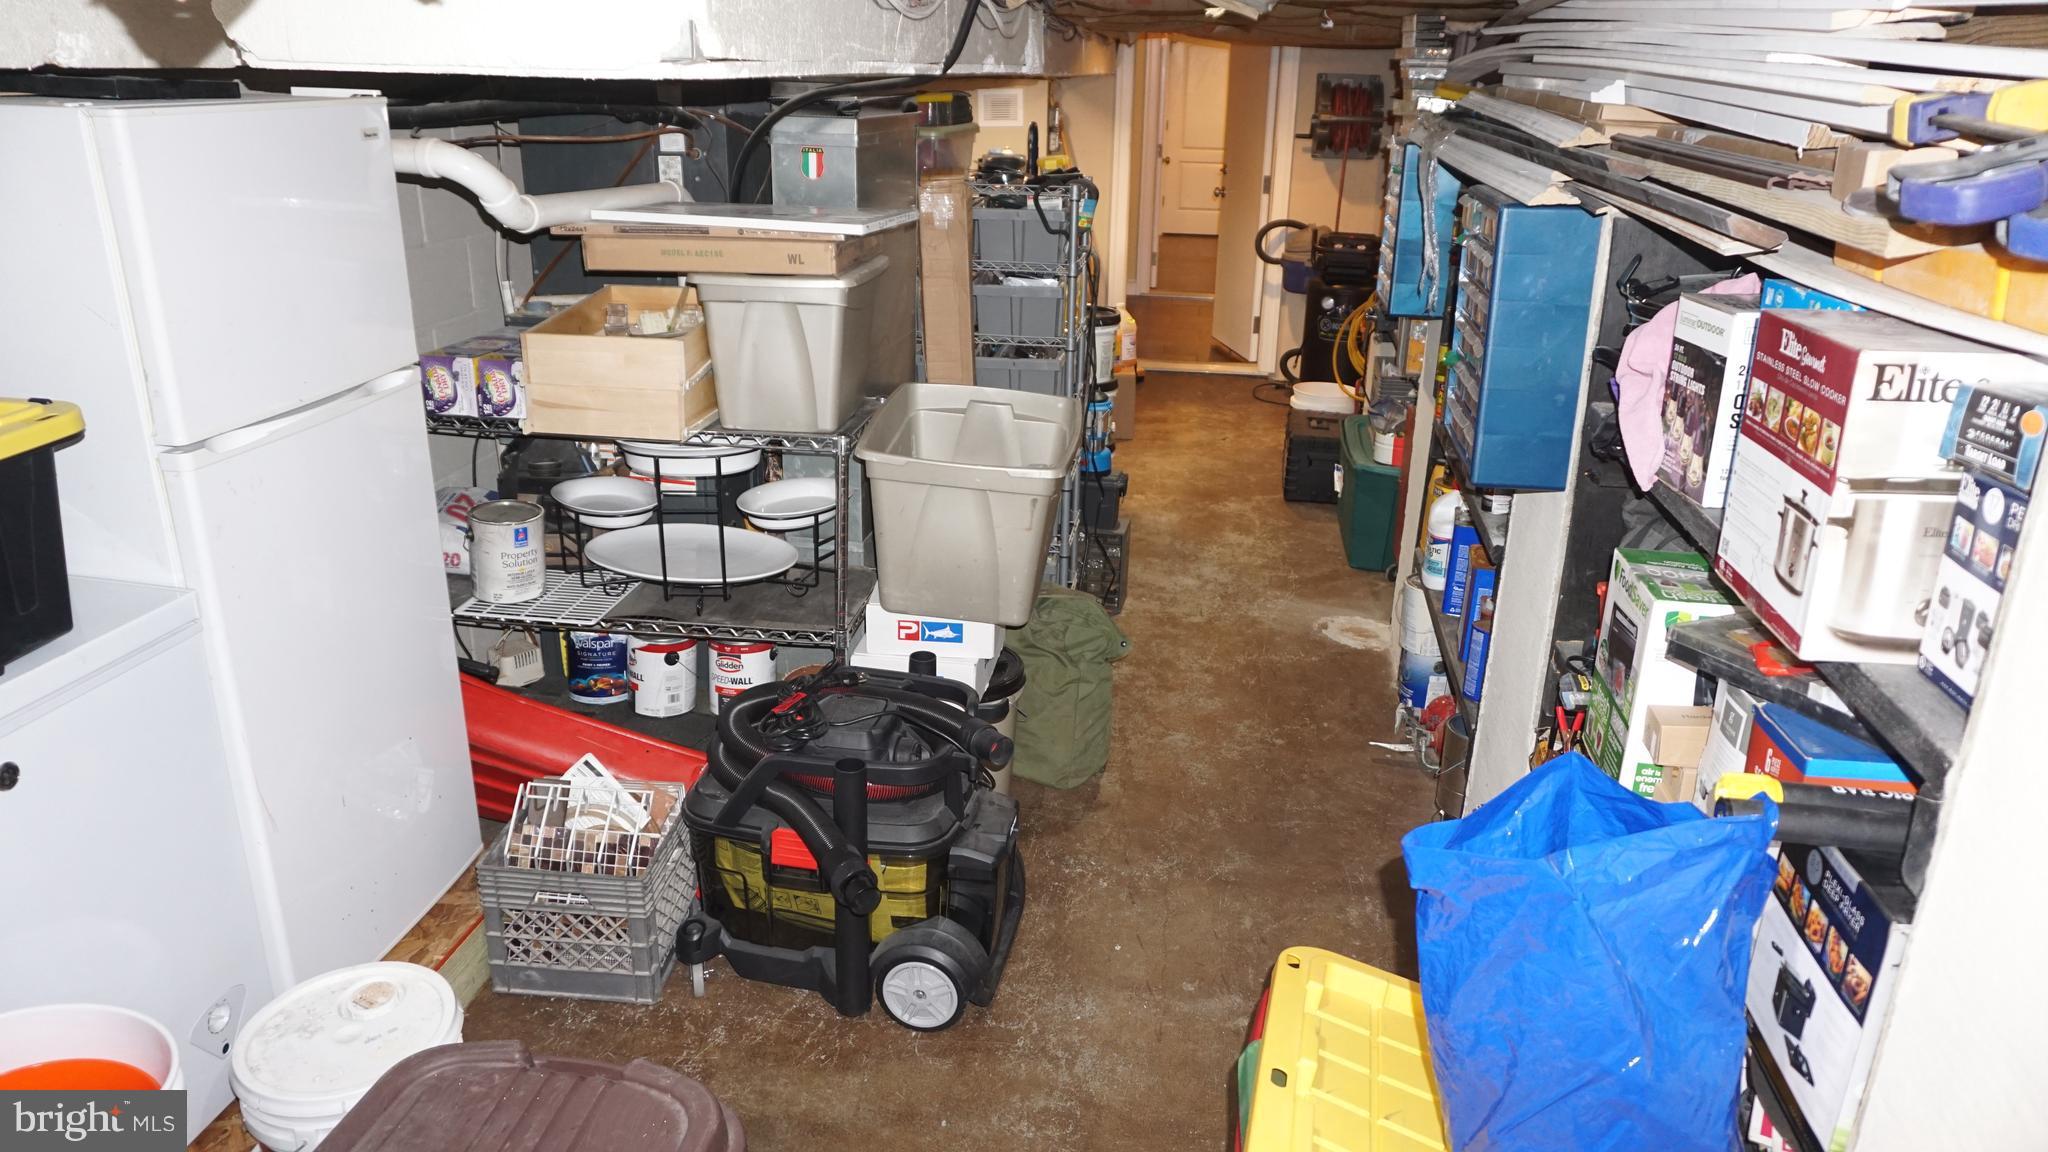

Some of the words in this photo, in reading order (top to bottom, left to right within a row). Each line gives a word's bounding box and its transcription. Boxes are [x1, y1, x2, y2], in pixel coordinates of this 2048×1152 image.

[788, 254, 805, 265] WL
[1779, 327, 1802, 361] Elite
[1756, 351, 1785, 373] STAINLESS
[1785, 365, 1802, 382] STEEL
[1803, 375, 1821, 392] SLOW
[1820, 385, 1848, 406] COOKER
[1866, 363, 1962, 403] Elite
[500, 548, 538, 561] Property
[502, 556, 538, 568] Solution
[1619, 567, 1649, 618] FoodSaver
[578, 637, 615, 651] valspar
[715, 659, 744, 670] Glidden
